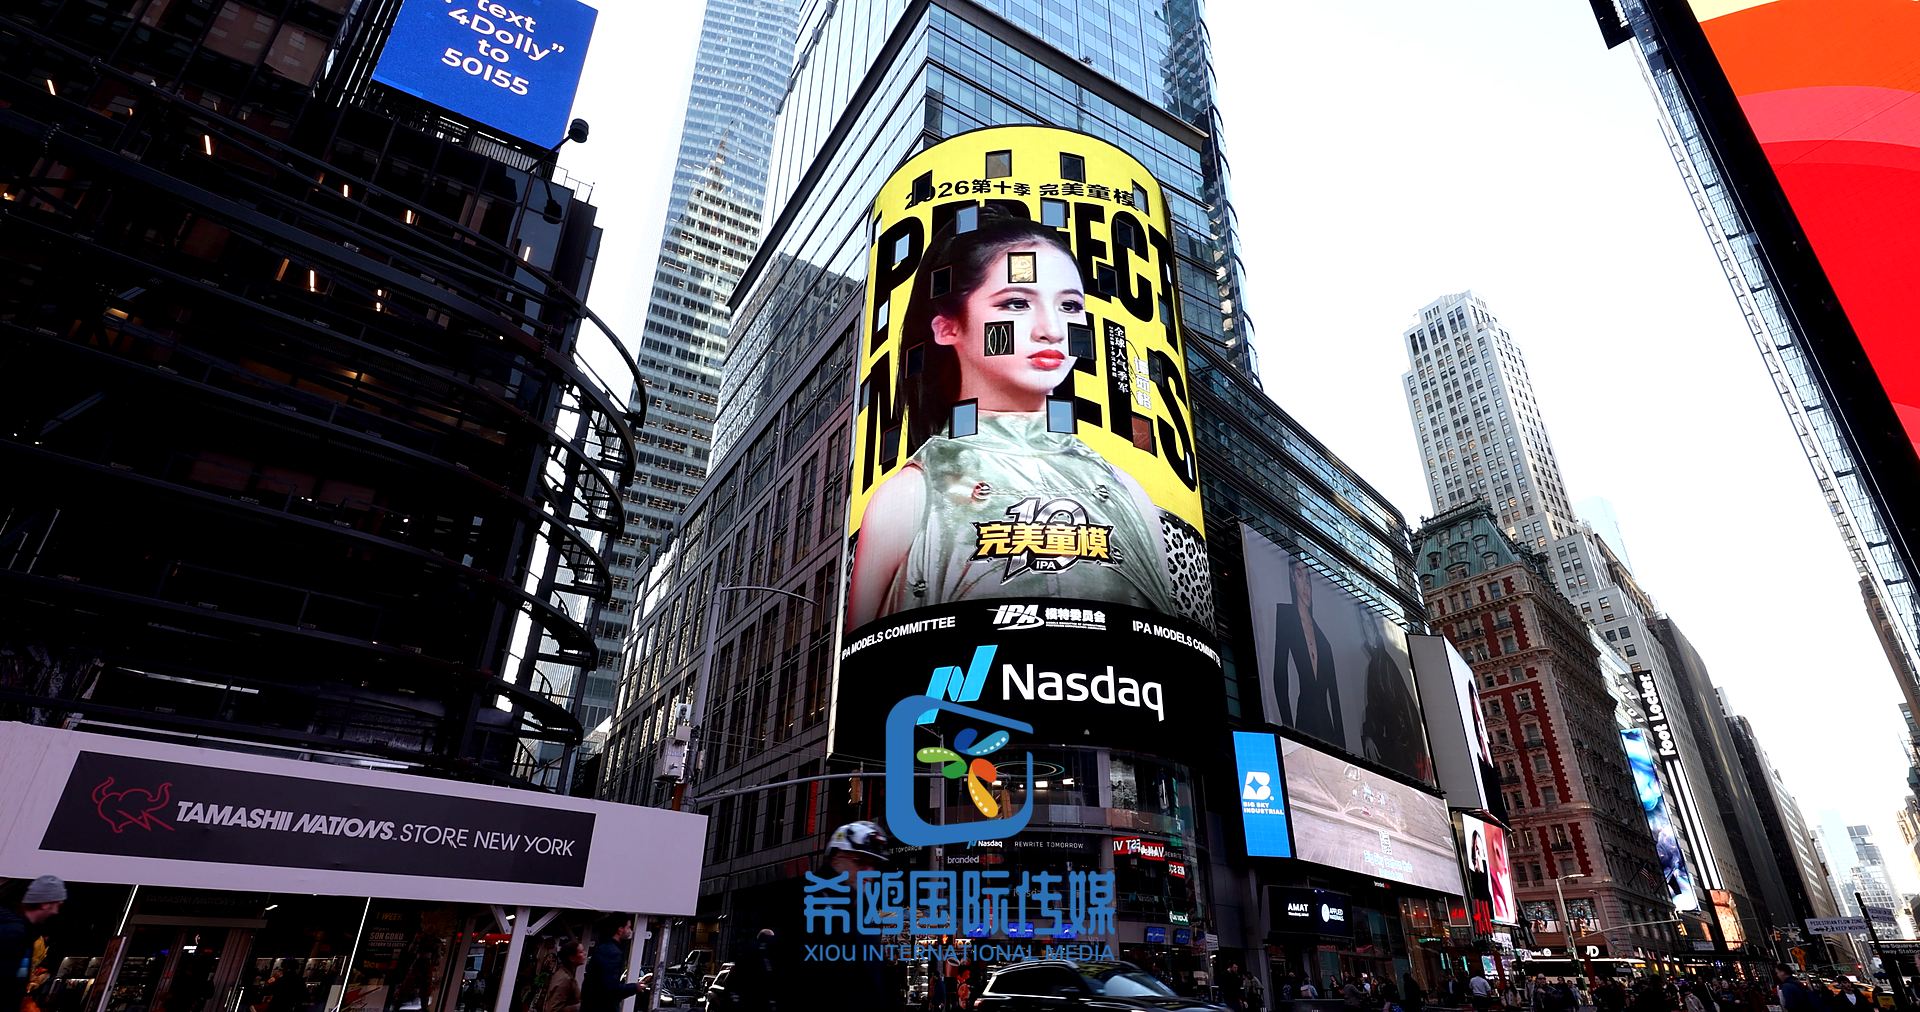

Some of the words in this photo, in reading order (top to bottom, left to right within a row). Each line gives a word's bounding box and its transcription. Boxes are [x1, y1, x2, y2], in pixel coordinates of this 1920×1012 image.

[477, 0, 537, 33] text
[478, 39, 510, 63] to
[441, 47, 530, 96] 50155
[977, 522, 1111, 559] 完美童模
[1036, 560, 1056, 570] IPA
[992, 604, 1039, 625] IPA
[851, 631, 884, 655] MODELS
[884, 616, 955, 641] COMMITTEE
[1132, 620, 1152, 634] IPA
[1153, 625, 1193, 647] MODELS
[1001, 663, 1165, 722] Nasdaq
[1639, 674, 1665, 721] Locker
[1653, 723, 1676, 756] Foot
[176, 800, 294, 832] TAMASHII
[294, 812, 394, 841] NATIONS
[400, 821, 468, 848] STORE
[473, 829, 521, 851] NEW
[524, 832, 576, 857] YORK
[947, 855, 980, 864] branded
[978, 840, 1003, 848] Nasdaq
[1046, 841, 1084, 849] TOMORROW
[1287, 902, 1309, 912] AMAT
[1586, 945, 1600, 957] JD
